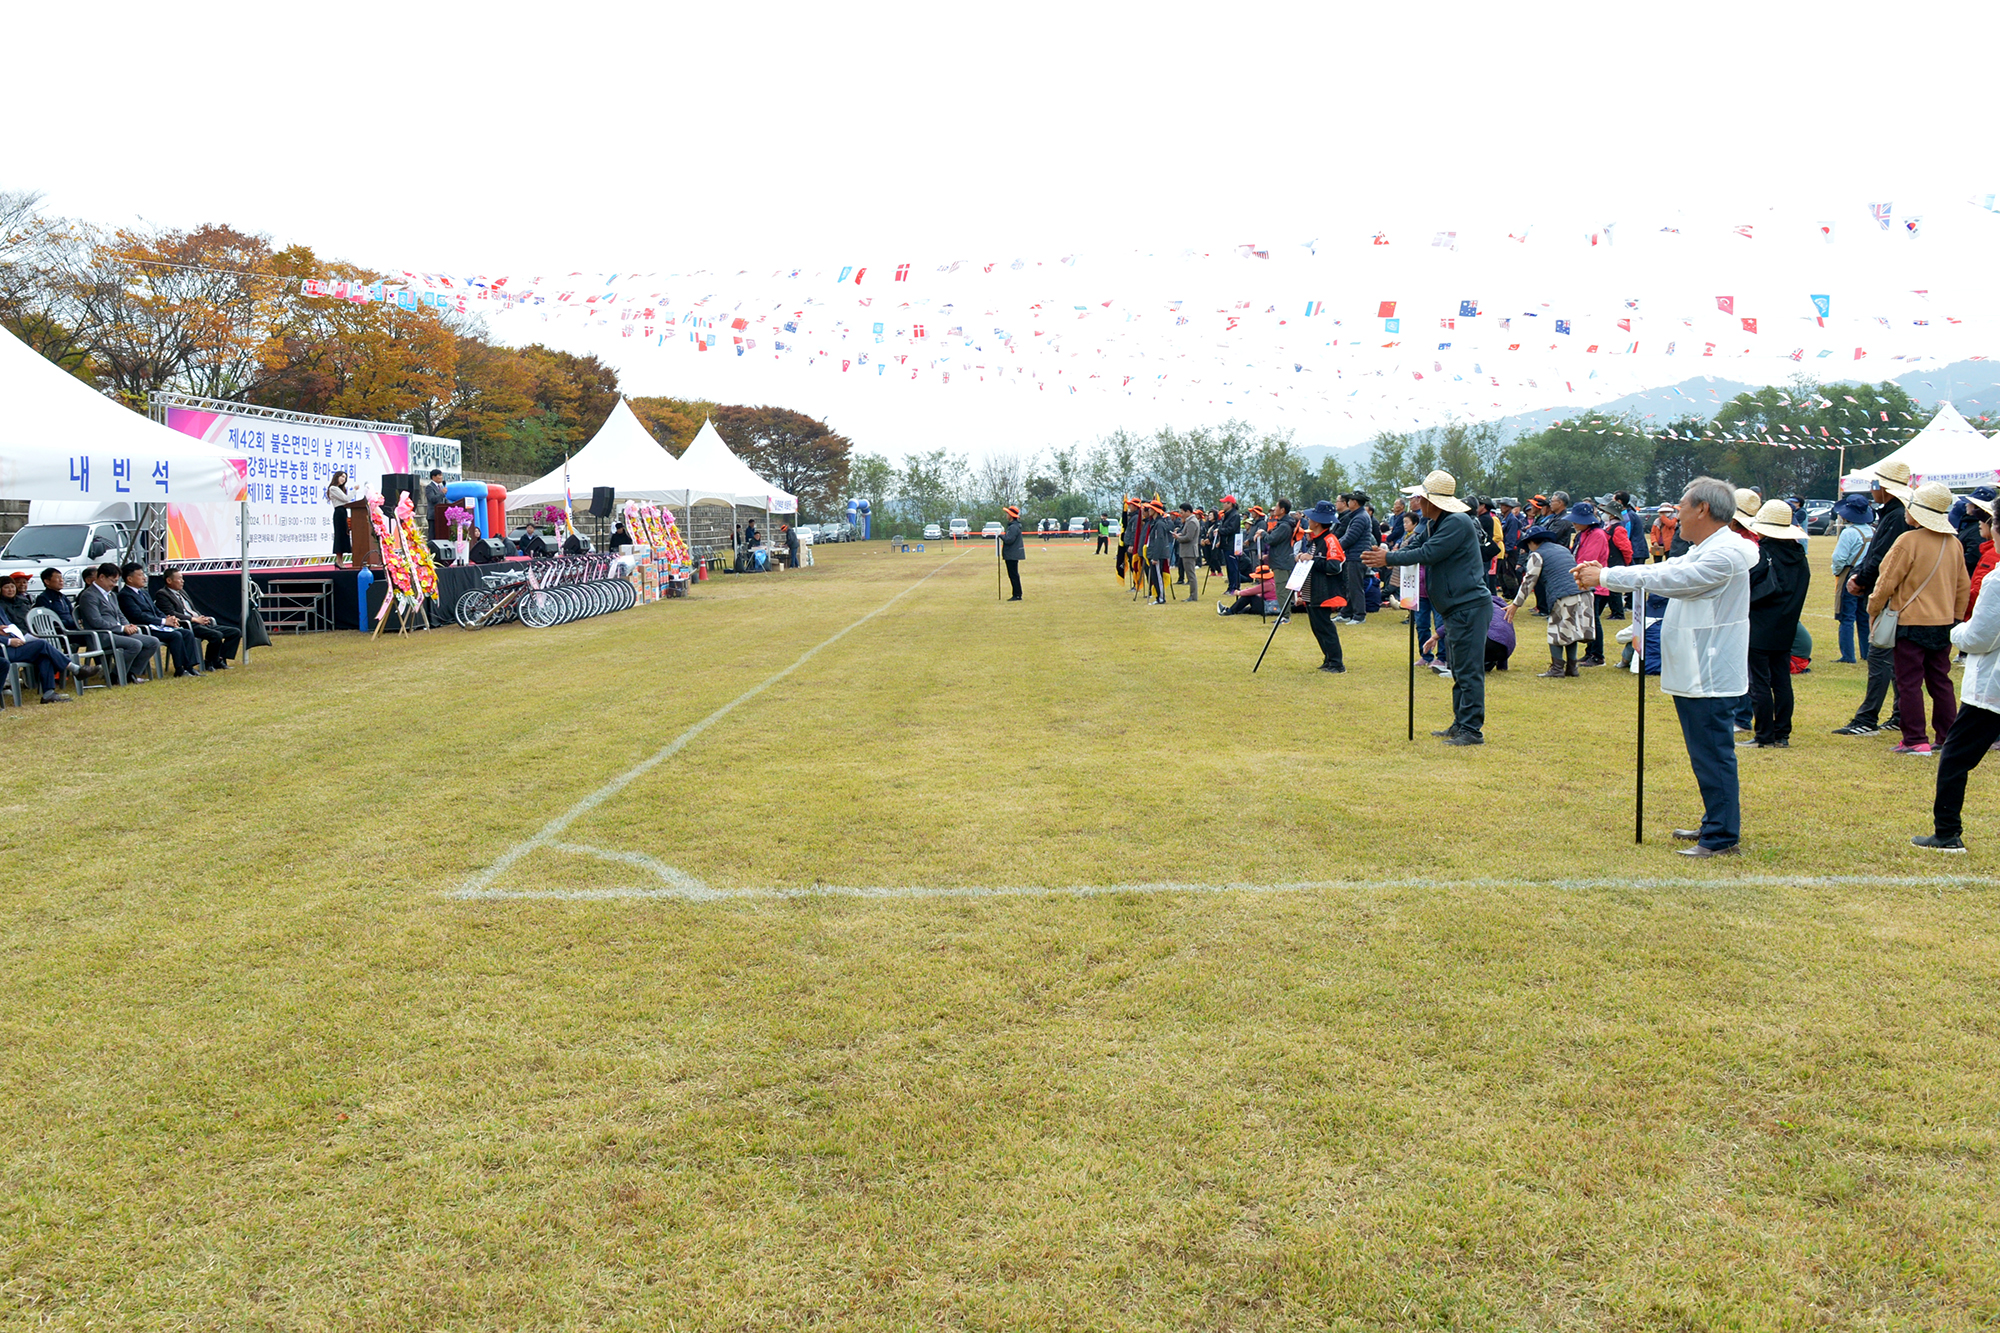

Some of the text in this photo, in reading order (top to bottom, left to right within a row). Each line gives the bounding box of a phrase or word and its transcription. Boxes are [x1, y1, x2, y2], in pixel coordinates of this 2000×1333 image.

[229, 428, 371, 460] 제42회 불은면민의 날 기념식 및
[247, 457, 308, 481] 강화남부농협
[247, 480, 274, 504] 제11회
[279, 484, 318, 504] 불은면민
